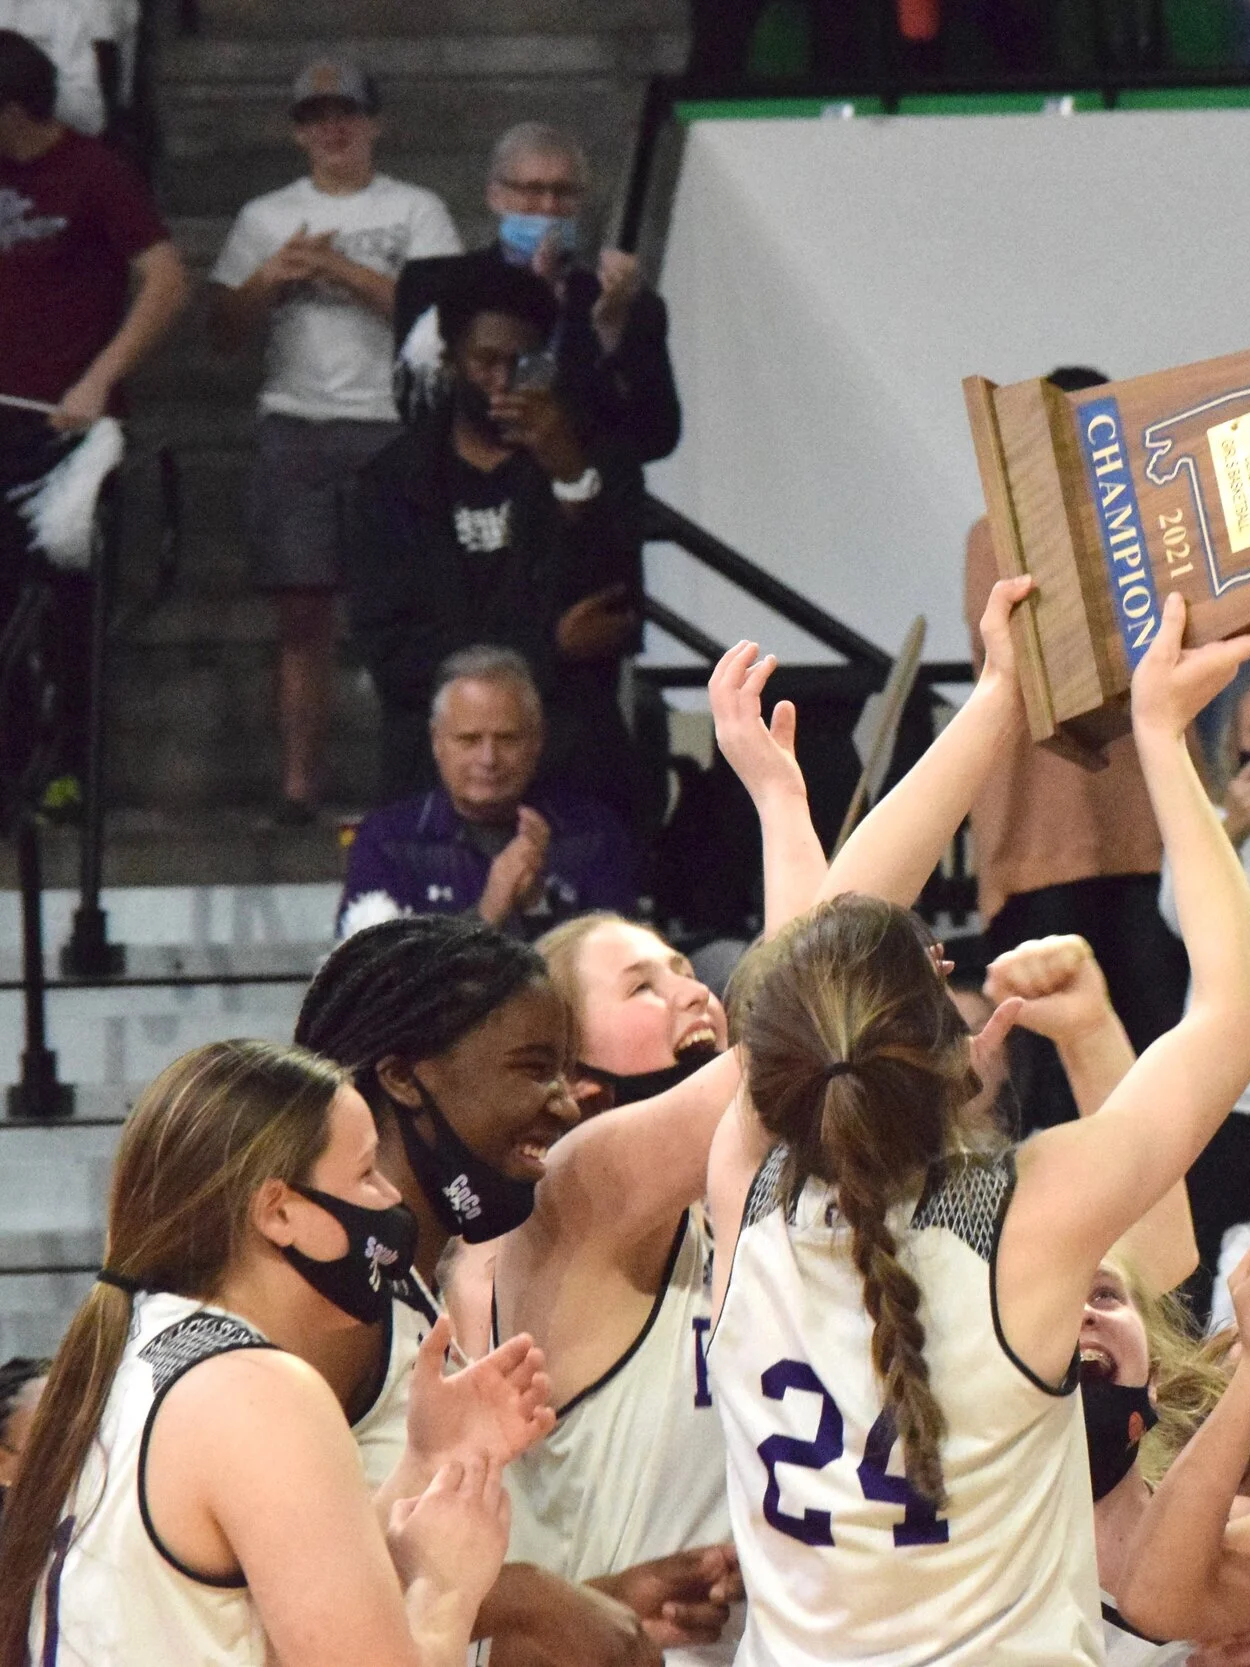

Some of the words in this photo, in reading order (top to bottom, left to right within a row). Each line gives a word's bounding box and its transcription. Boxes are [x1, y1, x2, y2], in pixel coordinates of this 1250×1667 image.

[1221, 439, 1240, 468] GIRLS
[1087, 413, 1158, 650] CHAMPION
[1226, 468, 1250, 533] BASKETBALL
[1158, 507, 1195, 580] 2021
[756, 1357, 950, 1548] 24
